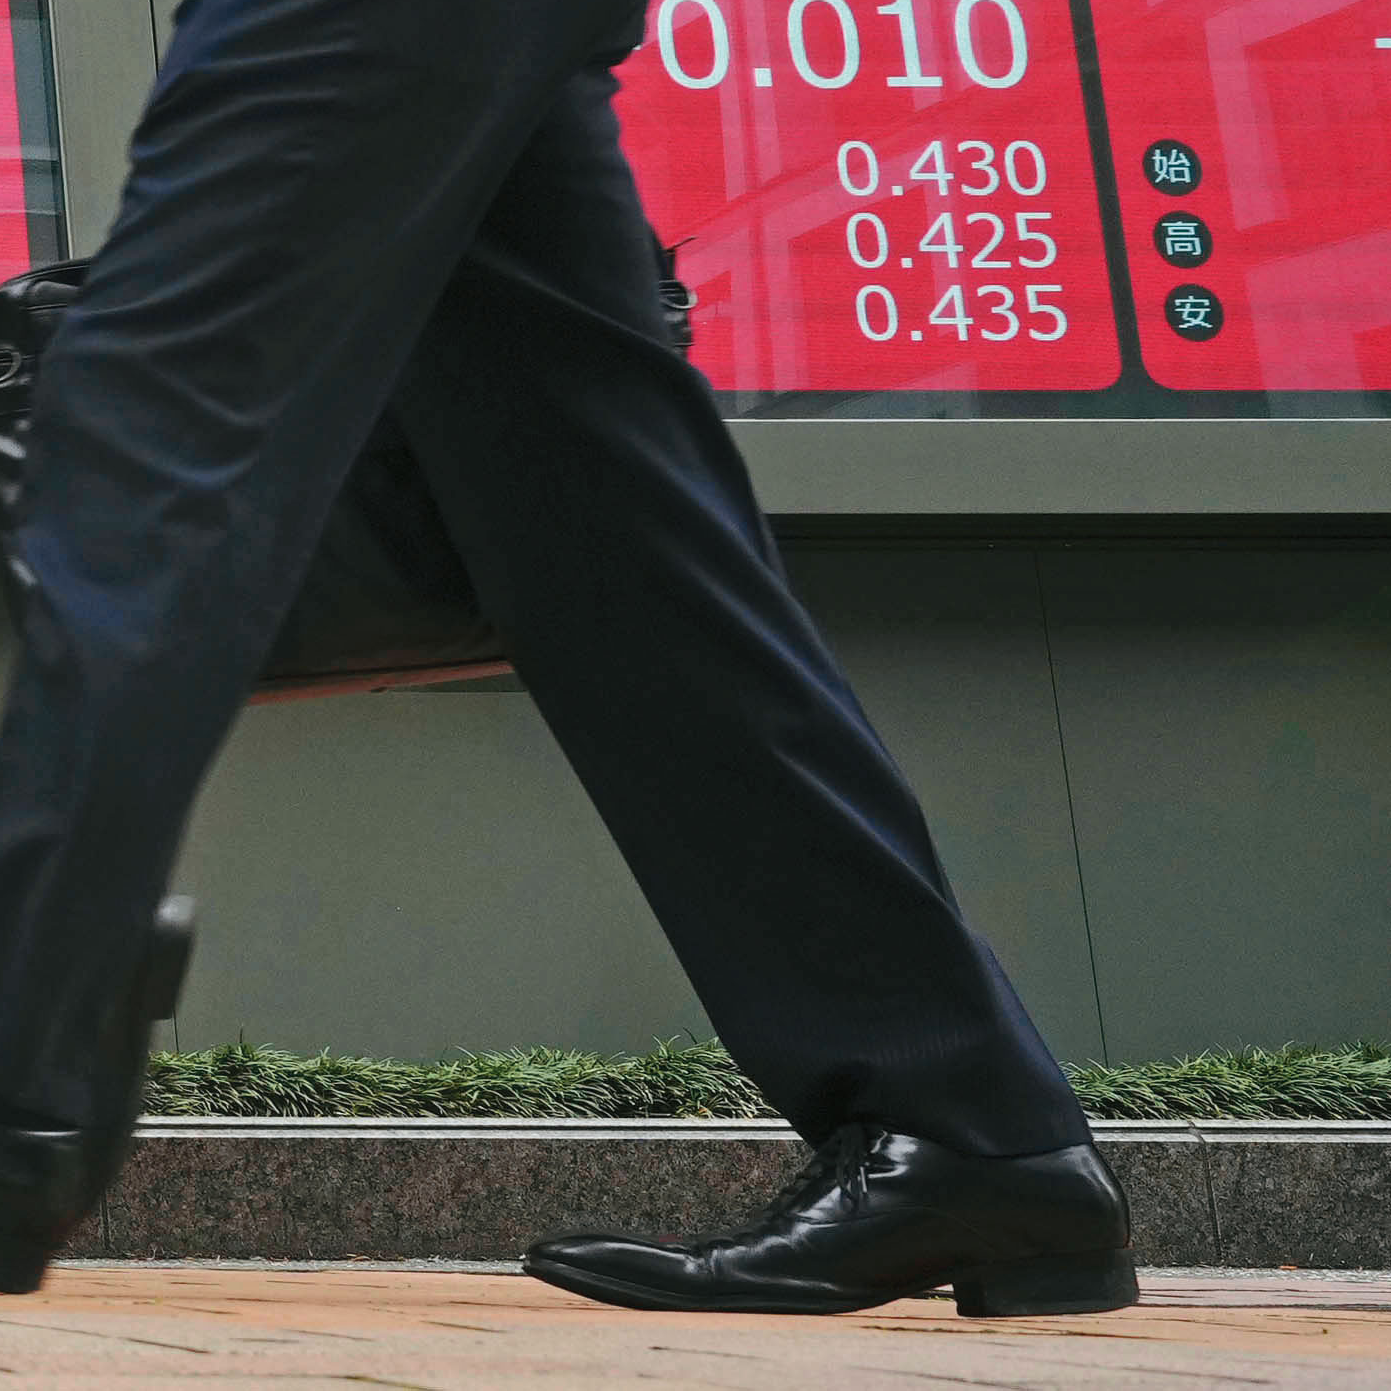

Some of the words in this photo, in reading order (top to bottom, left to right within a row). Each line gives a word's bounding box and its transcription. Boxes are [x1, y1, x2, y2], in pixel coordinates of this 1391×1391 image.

[836, 140, 1047, 197] 0.430
[1151, 148, 1191, 183] 始
[846, 211, 1057, 269] 0.425
[1161, 221, 1202, 256] 高
[855, 284, 1068, 342] 0.435
[1174, 295, 1213, 329] 安
